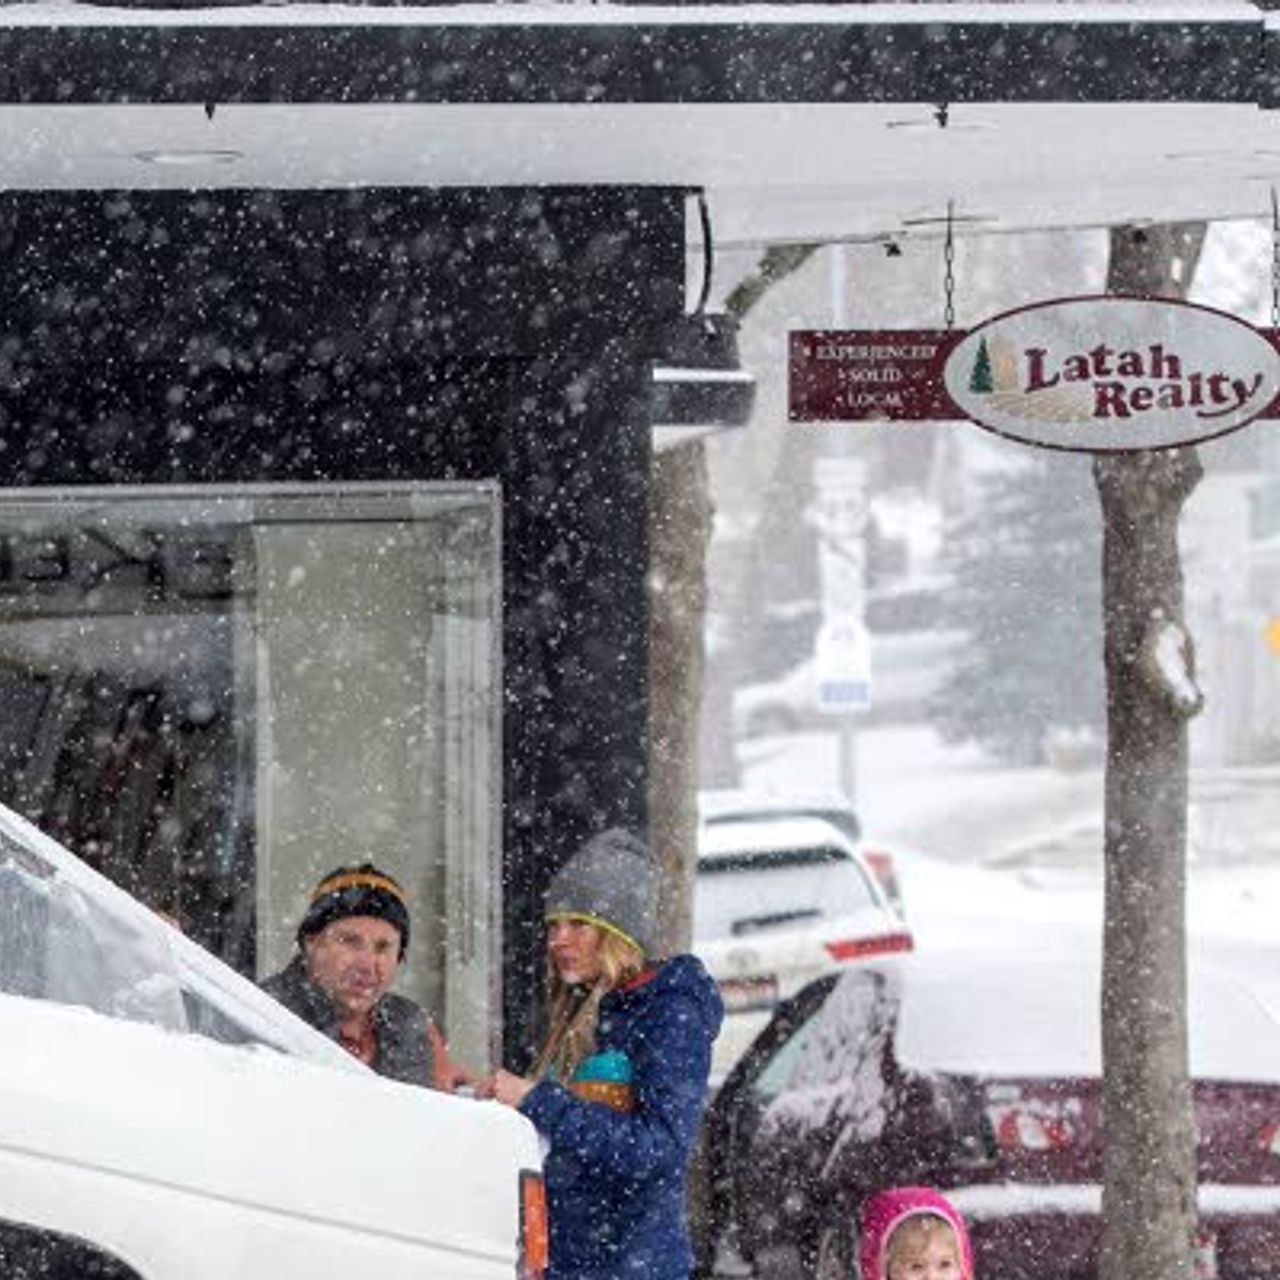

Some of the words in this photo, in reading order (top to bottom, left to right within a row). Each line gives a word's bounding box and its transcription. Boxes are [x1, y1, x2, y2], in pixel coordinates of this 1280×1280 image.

[816, 345, 937, 359] EXPERIENCED
[849, 367, 902, 382] SOLID
[1024, 344, 1181, 393] Latah
[1093, 371, 1263, 418] Realty
